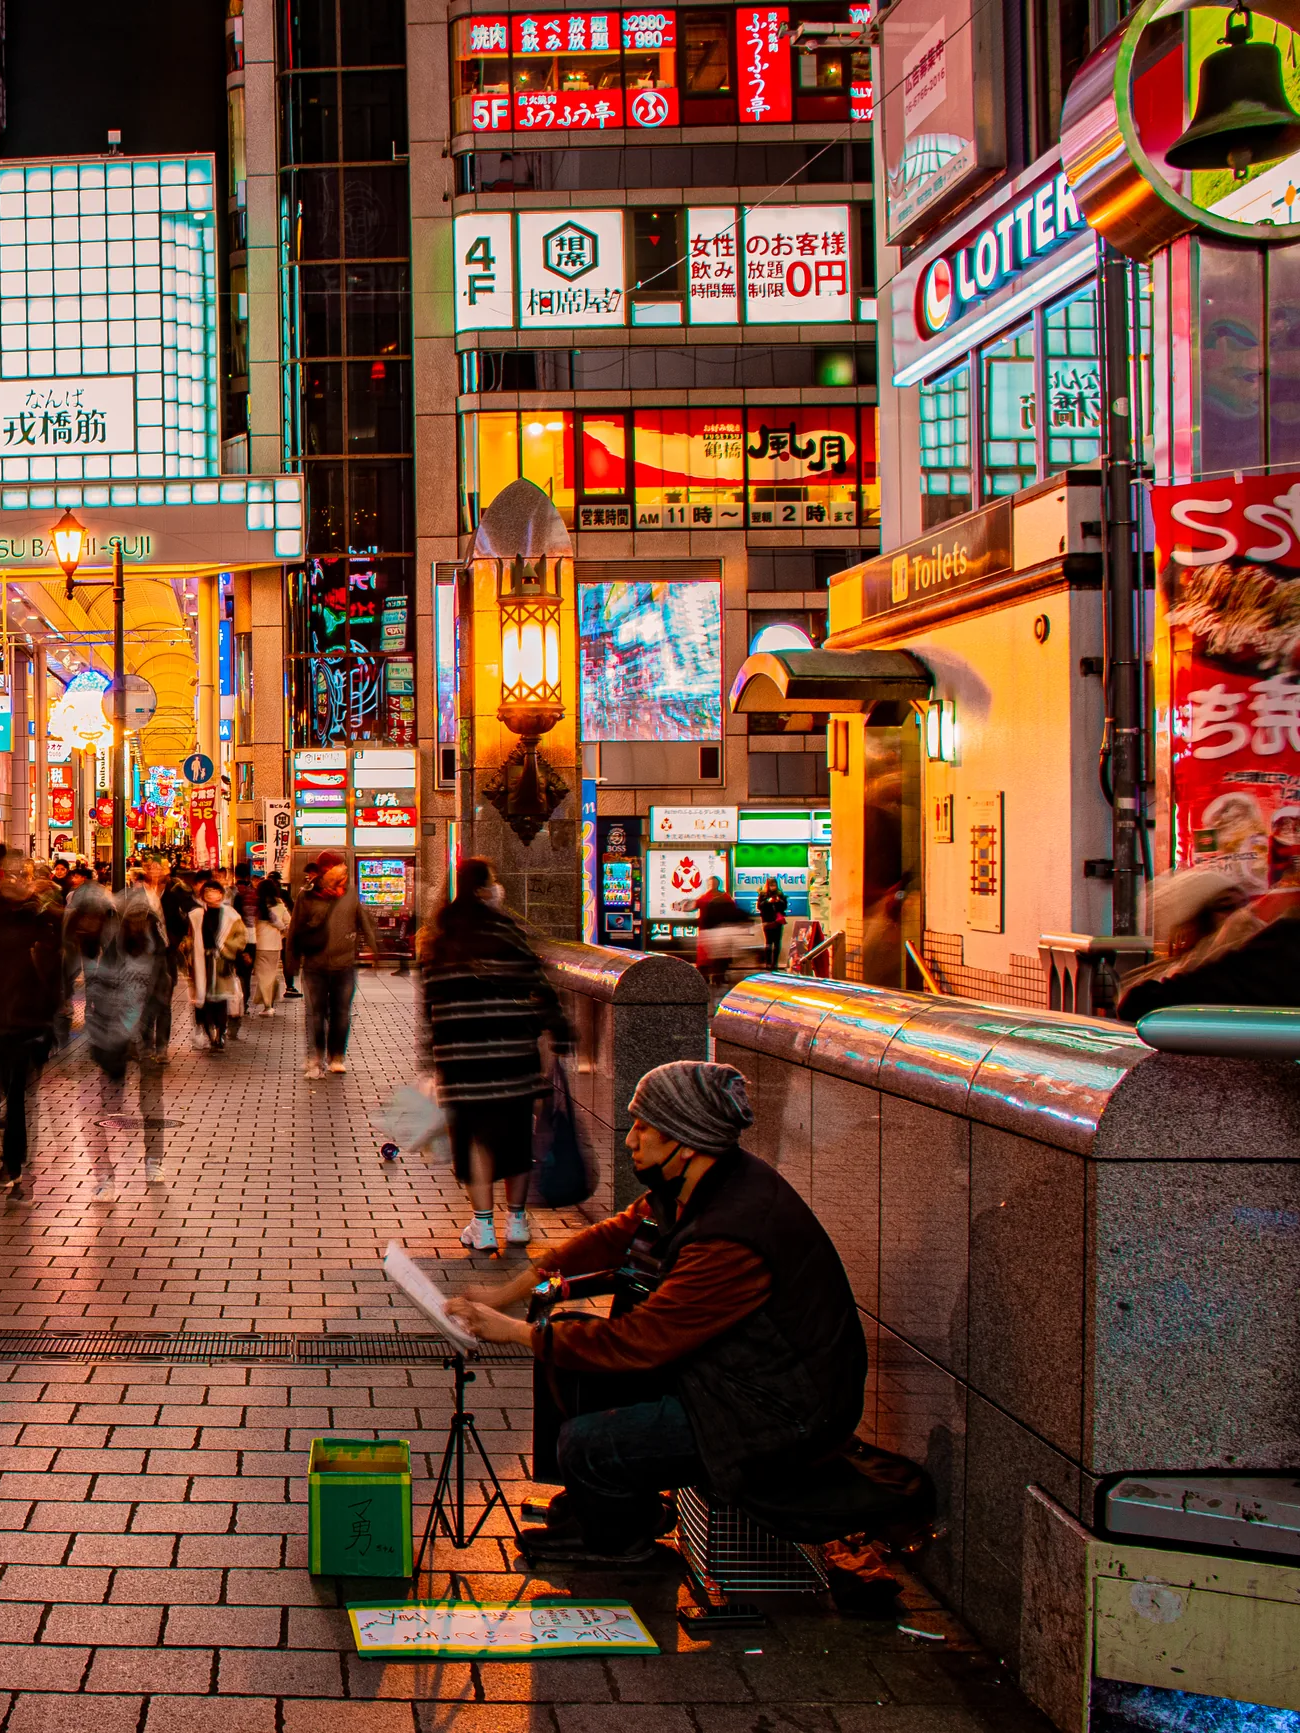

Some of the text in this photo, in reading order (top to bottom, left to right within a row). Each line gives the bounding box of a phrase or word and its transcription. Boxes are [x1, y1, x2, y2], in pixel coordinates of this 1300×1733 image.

[471, 23, 507, 49] 焼肉
[520, 16, 609, 36] 食べ放題
[767, 12, 779, 53] 炭火焼肉
[521, 32, 609, 52] 飲み放題
[746, 13, 771, 122] ふうふう亭
[473, 99, 509, 129] 5F
[519, 101, 615, 129] ふうふう亭
[555, 235, 587, 268] 相席
[690, 260, 785, 280] 飲み放題
[786, 259, 848, 298] 0円
[526, 287, 622, 316] 相席屋
[690, 282, 786, 299] 時間無制限
[26, 388, 85, 409] なんば
[3, 409, 108, 446] 戎橋筋
[703, 424, 741, 433] お好み焼き
[704, 441, 741, 459] 鶴橋
[748, 421, 847, 474] 風月
[581, 508, 629, 526] 営業時間
[638, 513, 660, 524] AM
[912, 541, 968, 591] Toilets
[651, 923, 671, 935] 入口
[345, 1498, 373, 1557] 勇
